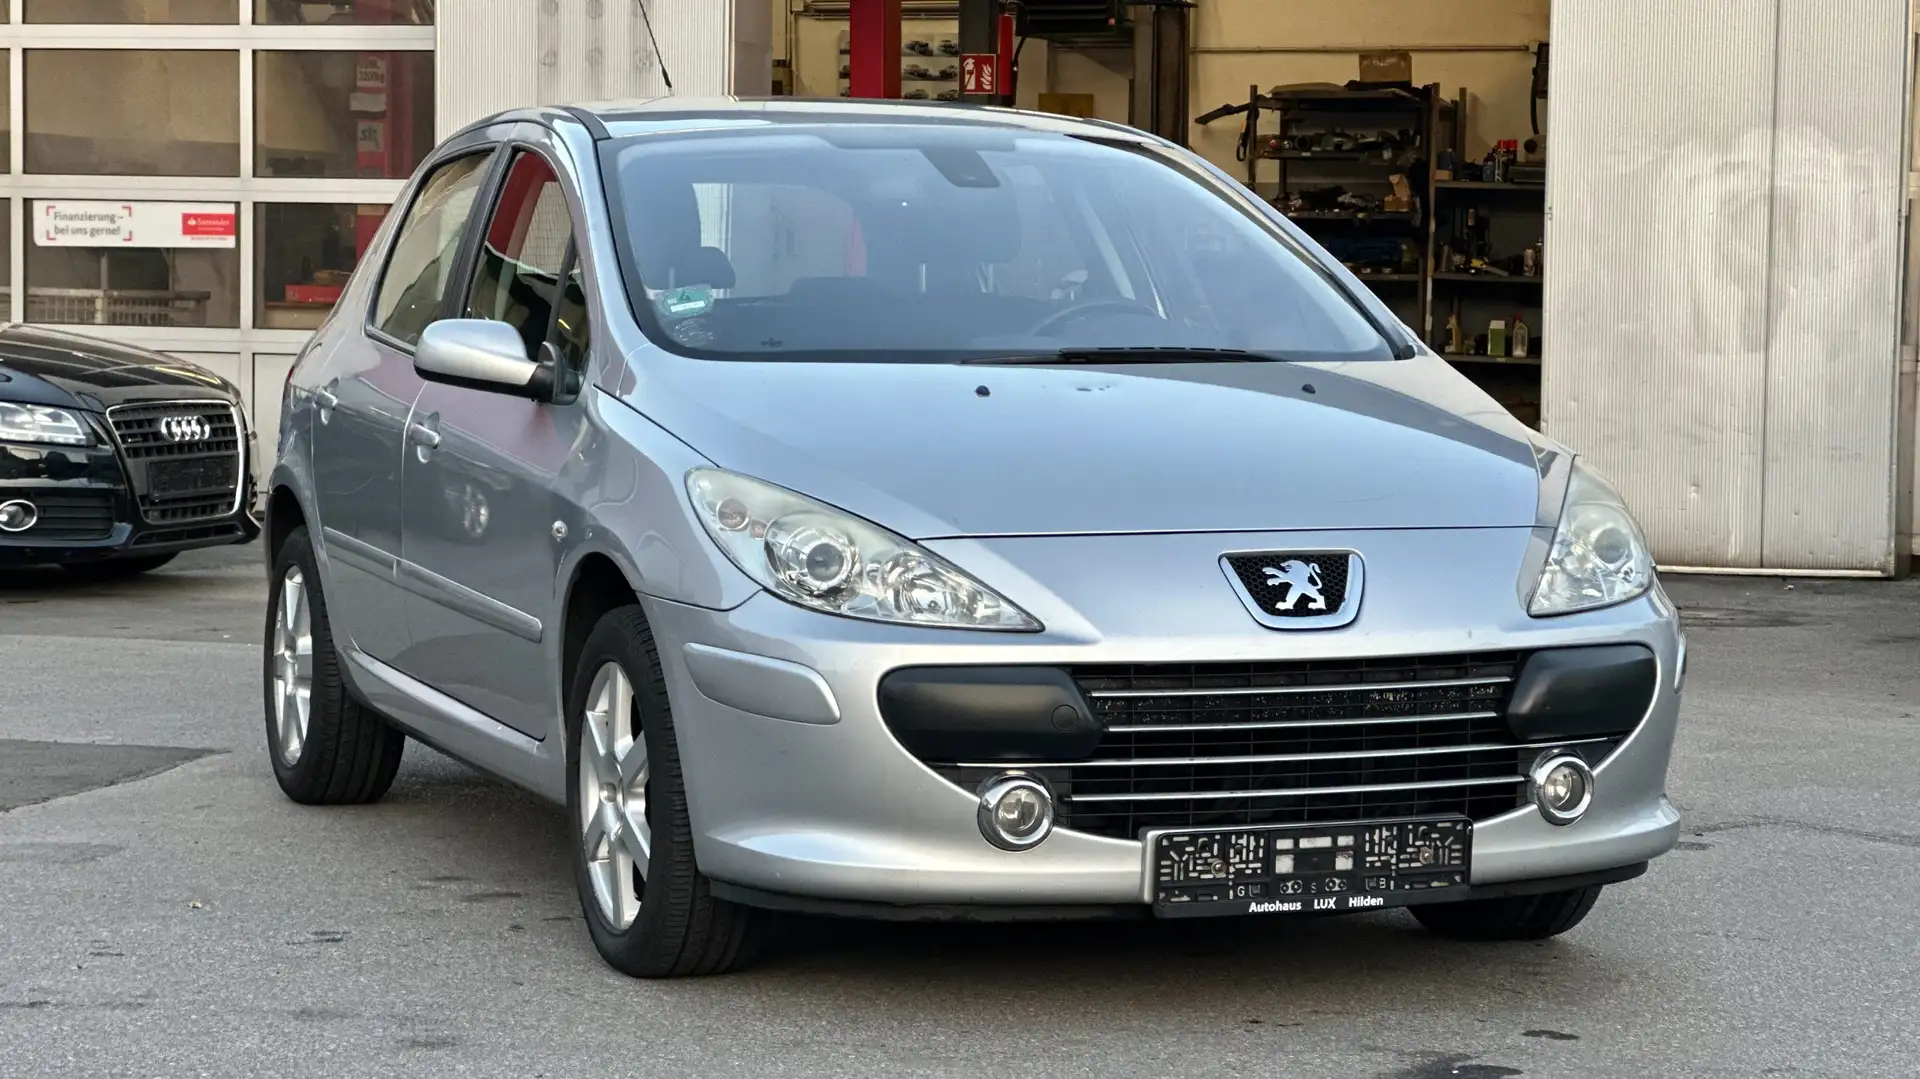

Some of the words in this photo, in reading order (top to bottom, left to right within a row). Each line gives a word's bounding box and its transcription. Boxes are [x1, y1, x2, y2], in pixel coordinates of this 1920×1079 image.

[54, 224, 69, 235] bei
[70, 227, 87, 235] uns
[89, 225, 121, 238] gerne!
[1248, 900, 1302, 913] Autohaus
[1313, 897, 1337, 910] LUX
[1348, 895, 1384, 908] Hilden
